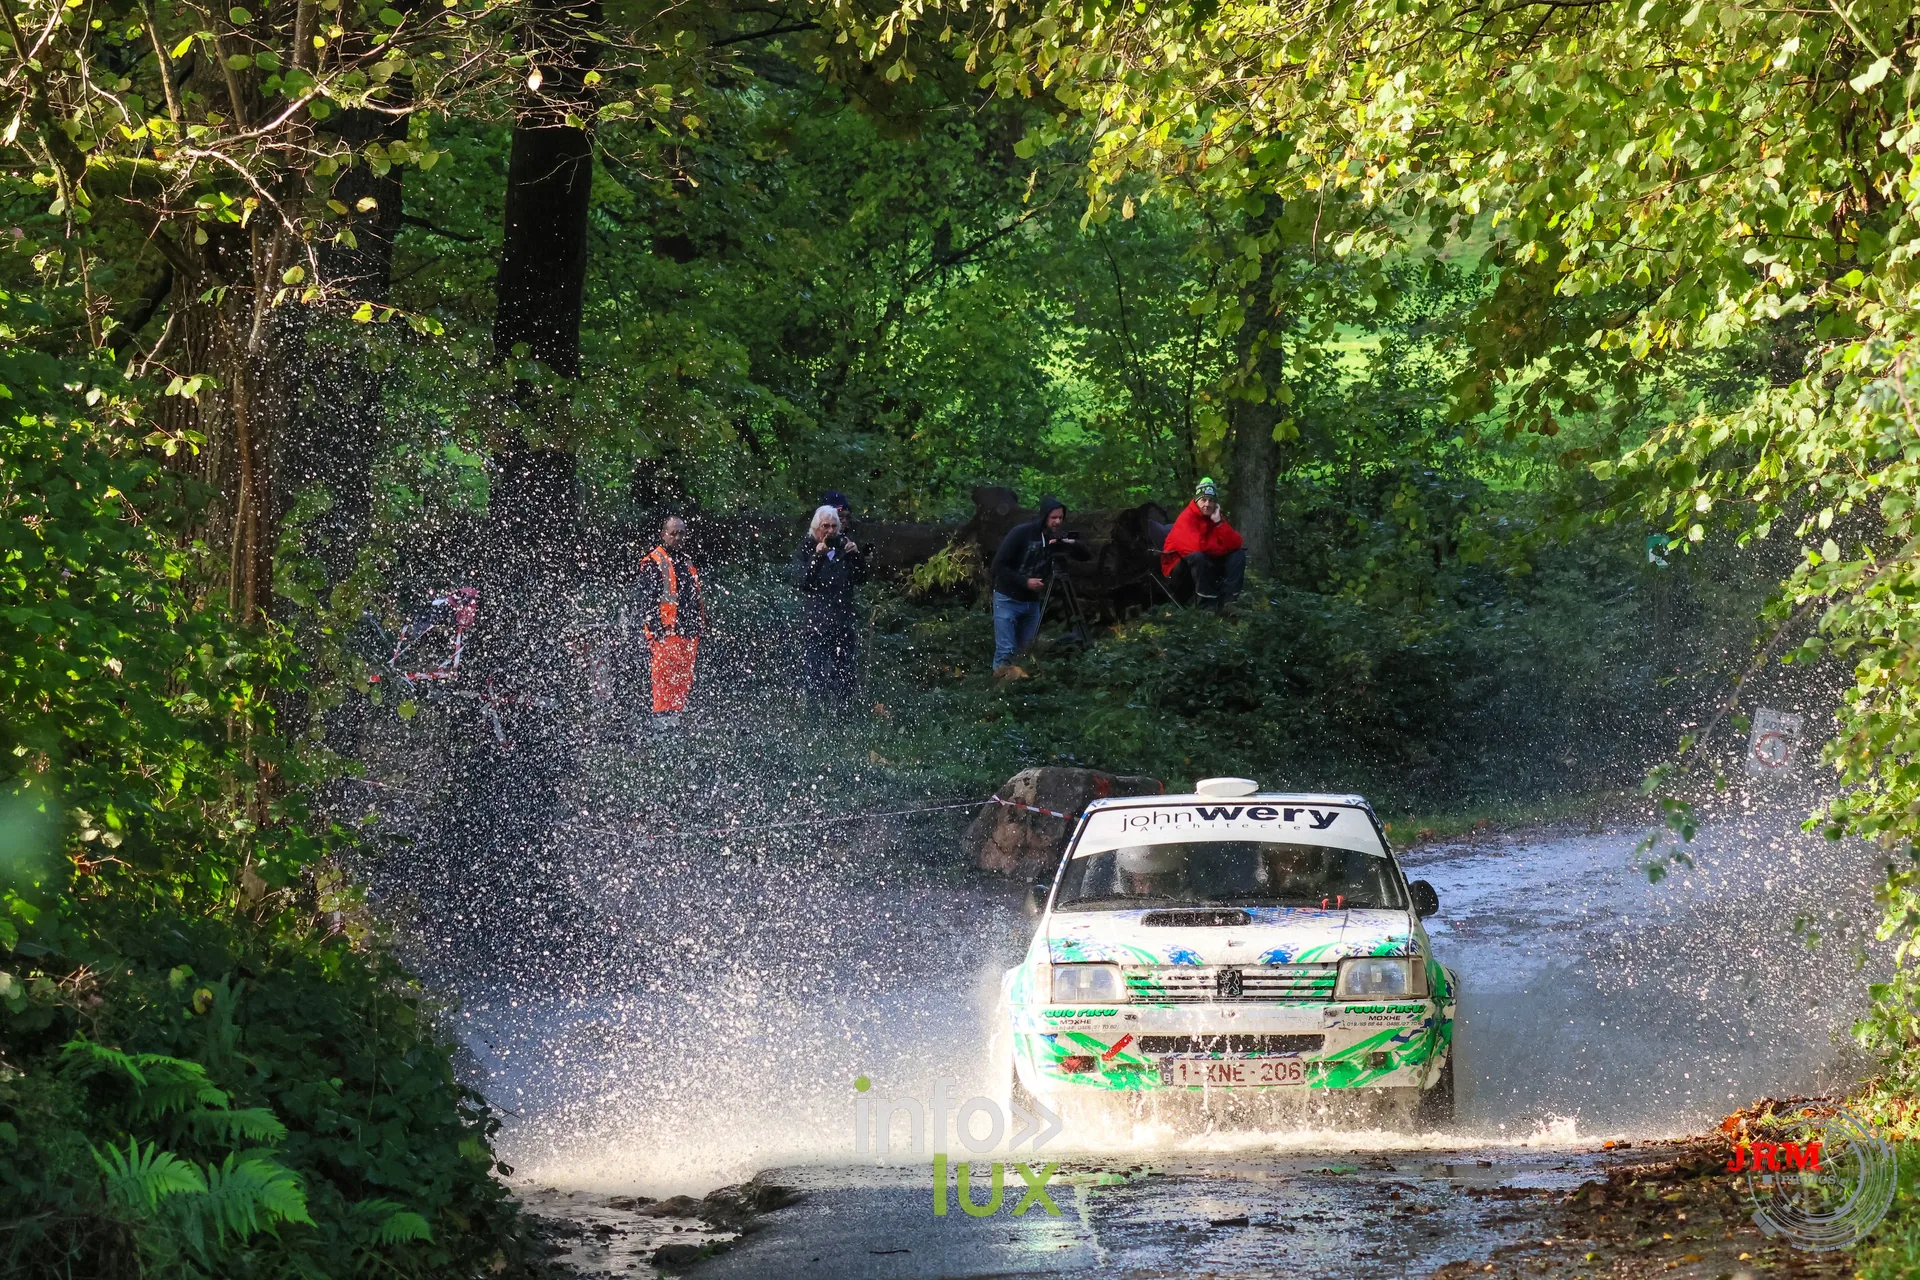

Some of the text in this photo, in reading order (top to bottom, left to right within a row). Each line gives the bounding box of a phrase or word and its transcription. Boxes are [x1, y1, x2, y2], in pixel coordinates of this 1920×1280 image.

[1121, 806, 1340, 832] john wery
[1140, 823, 1301, 832] Architecte
